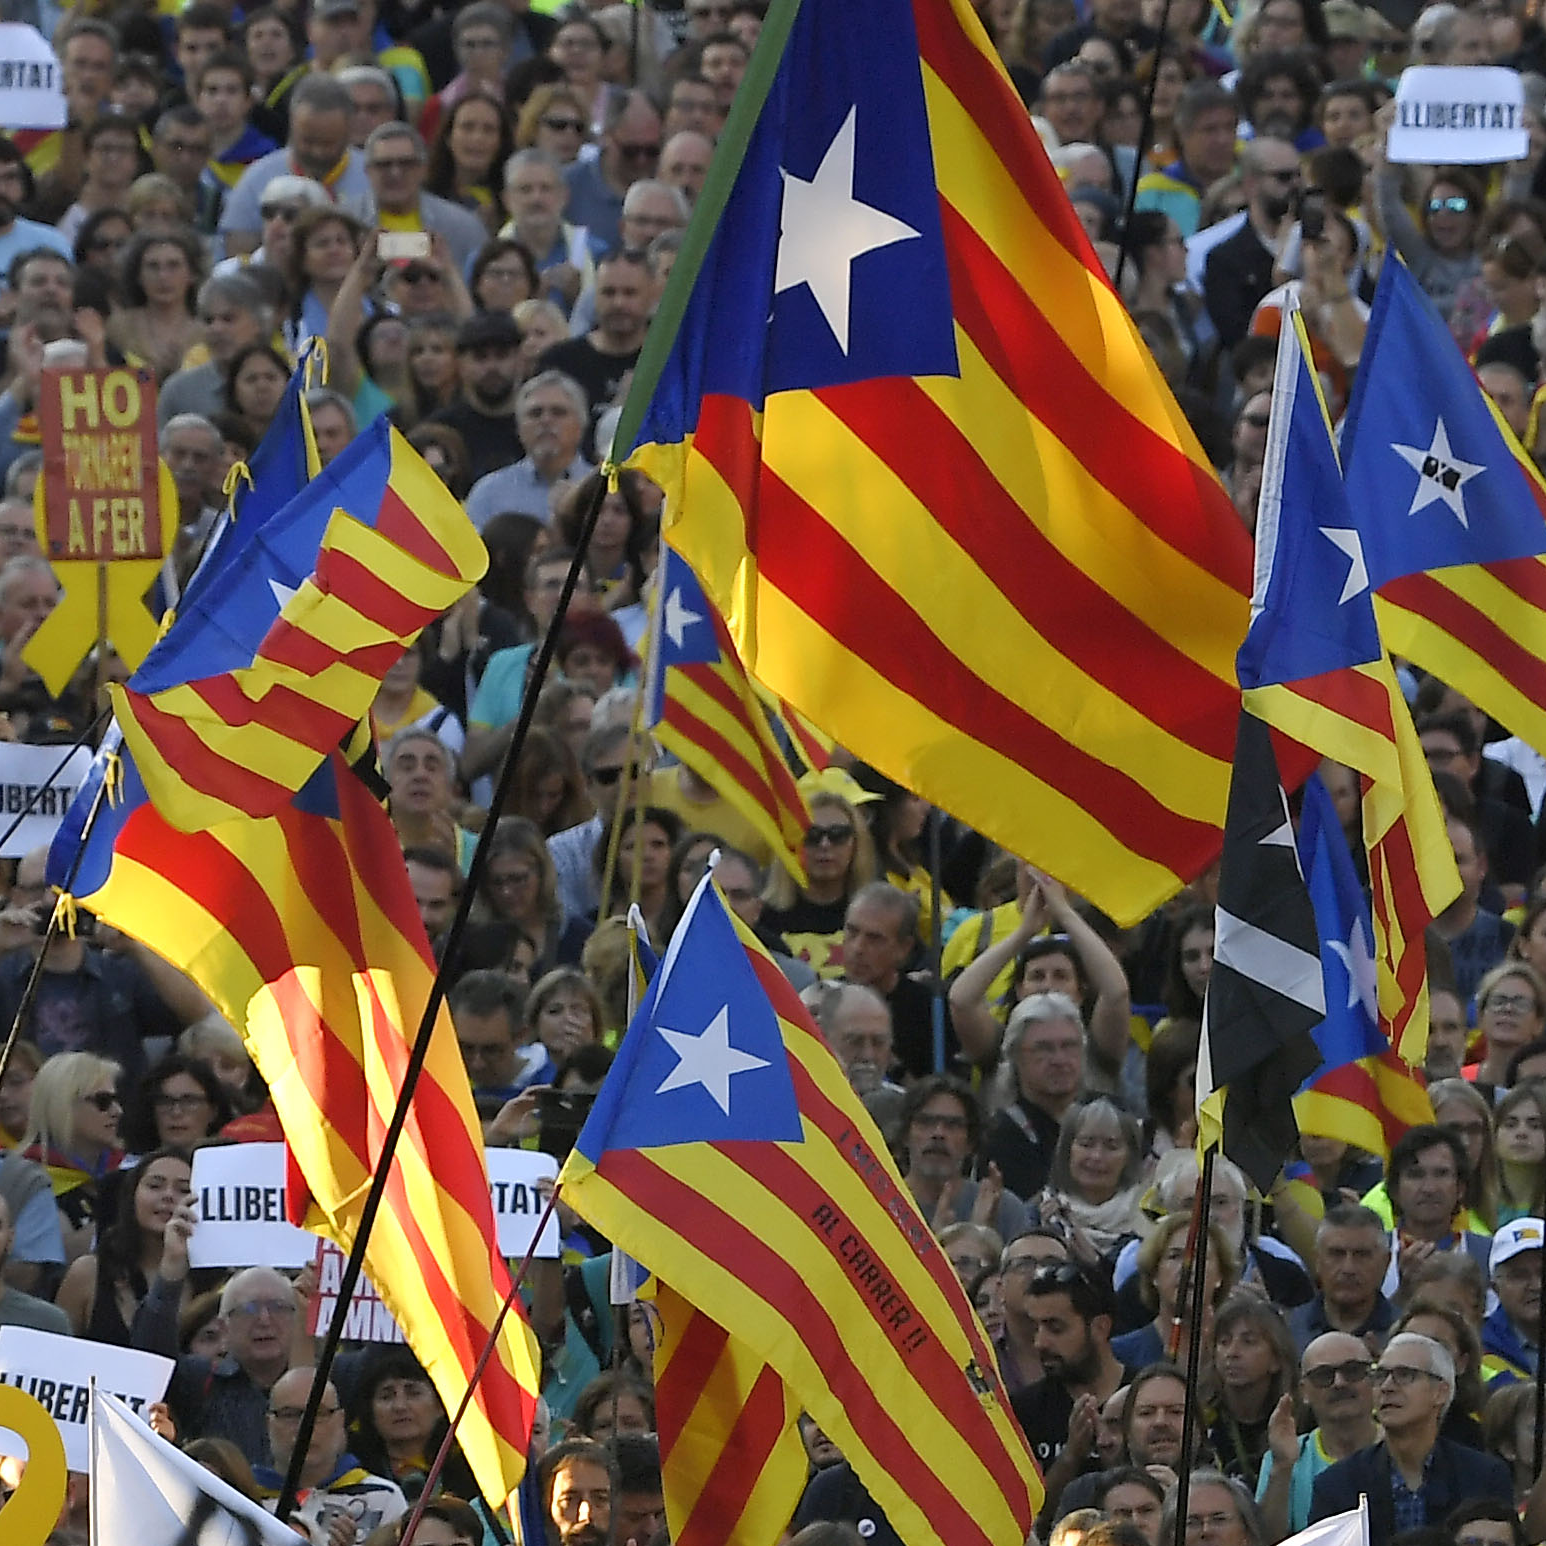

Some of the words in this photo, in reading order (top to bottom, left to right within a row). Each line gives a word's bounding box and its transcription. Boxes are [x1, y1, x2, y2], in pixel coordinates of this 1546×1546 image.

[1400, 102, 1516, 130] LLIBERTAT
[59, 371, 143, 431] HO
[69, 498, 88, 554] A
[95, 496, 147, 554] FER
[810, 1202, 841, 1238] AL
[837, 1232, 914, 1334] CARRER
